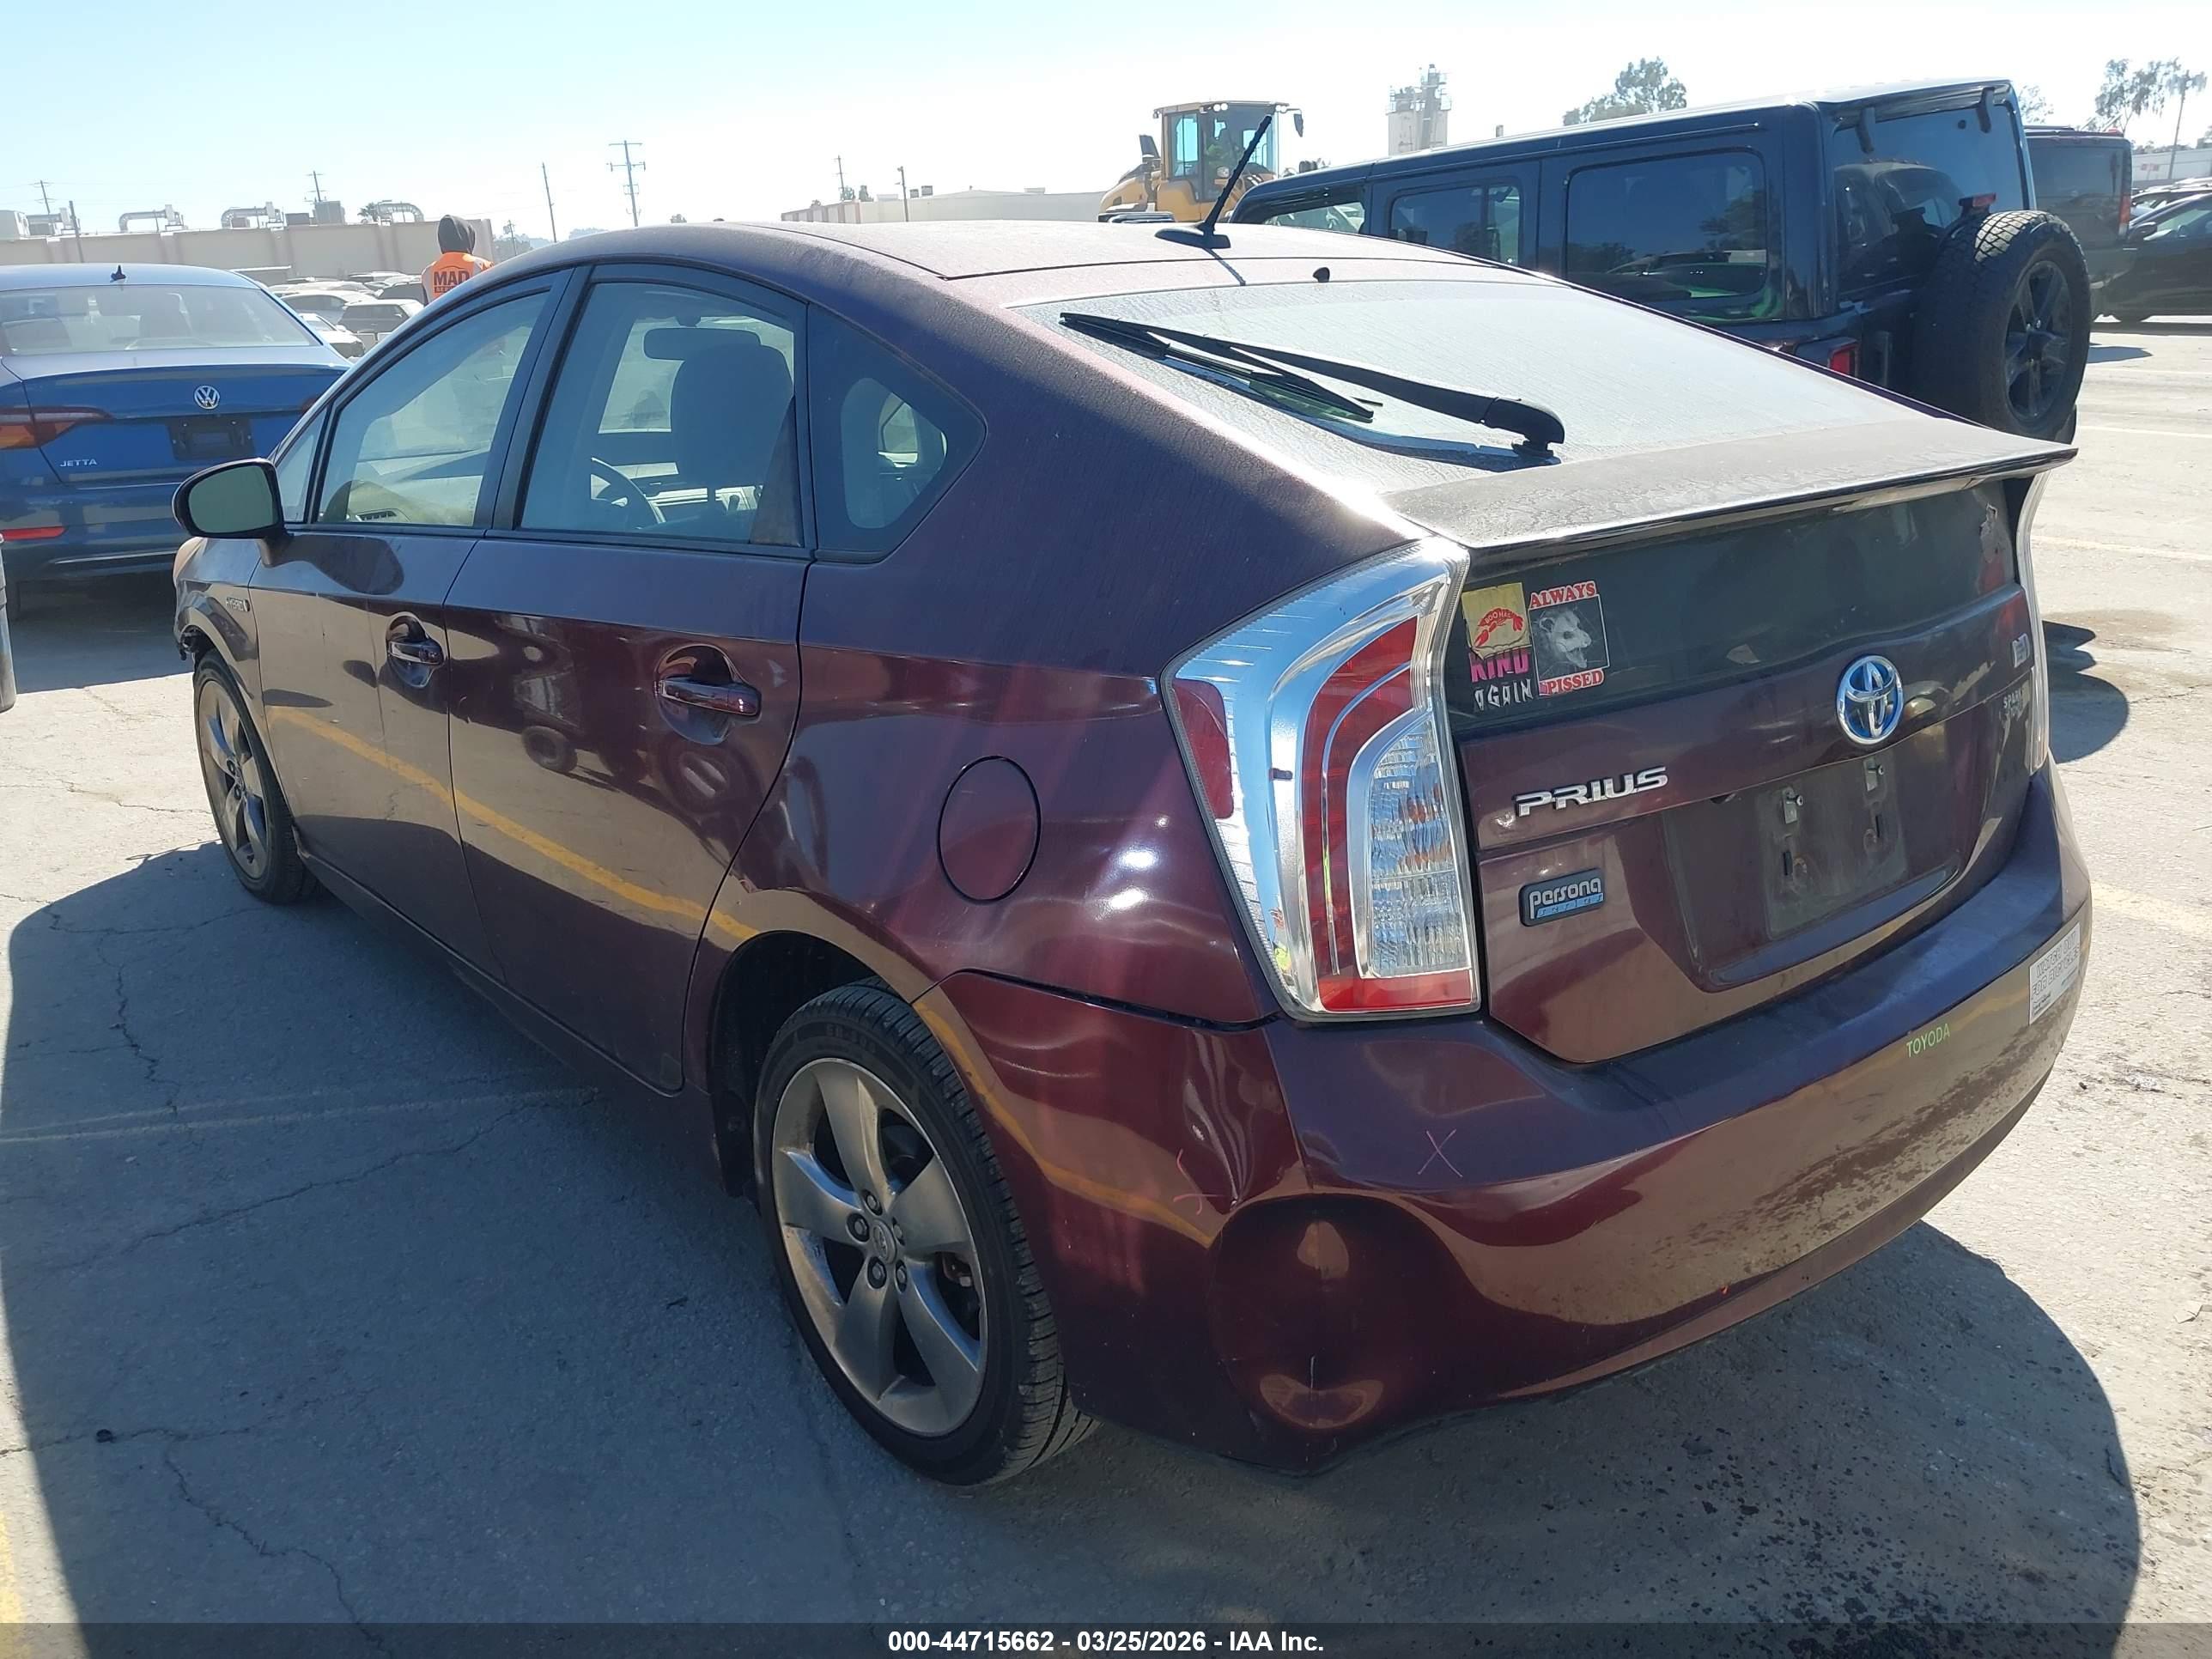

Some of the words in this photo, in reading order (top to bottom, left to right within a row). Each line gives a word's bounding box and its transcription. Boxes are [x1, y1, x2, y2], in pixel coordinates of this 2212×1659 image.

[434, 270, 471, 285] MAD
[59, 459, 98, 467] JETTA
[1529, 581, 1596, 608] ALWAYS
[1474, 678, 1534, 712] AGAIN
[1547, 672, 1604, 696] PISSED
[1513, 766, 1668, 817] PRIUS
[2033, 975, 2047, 996] FOR
[1905, 1023, 1950, 1058] TOYODA
